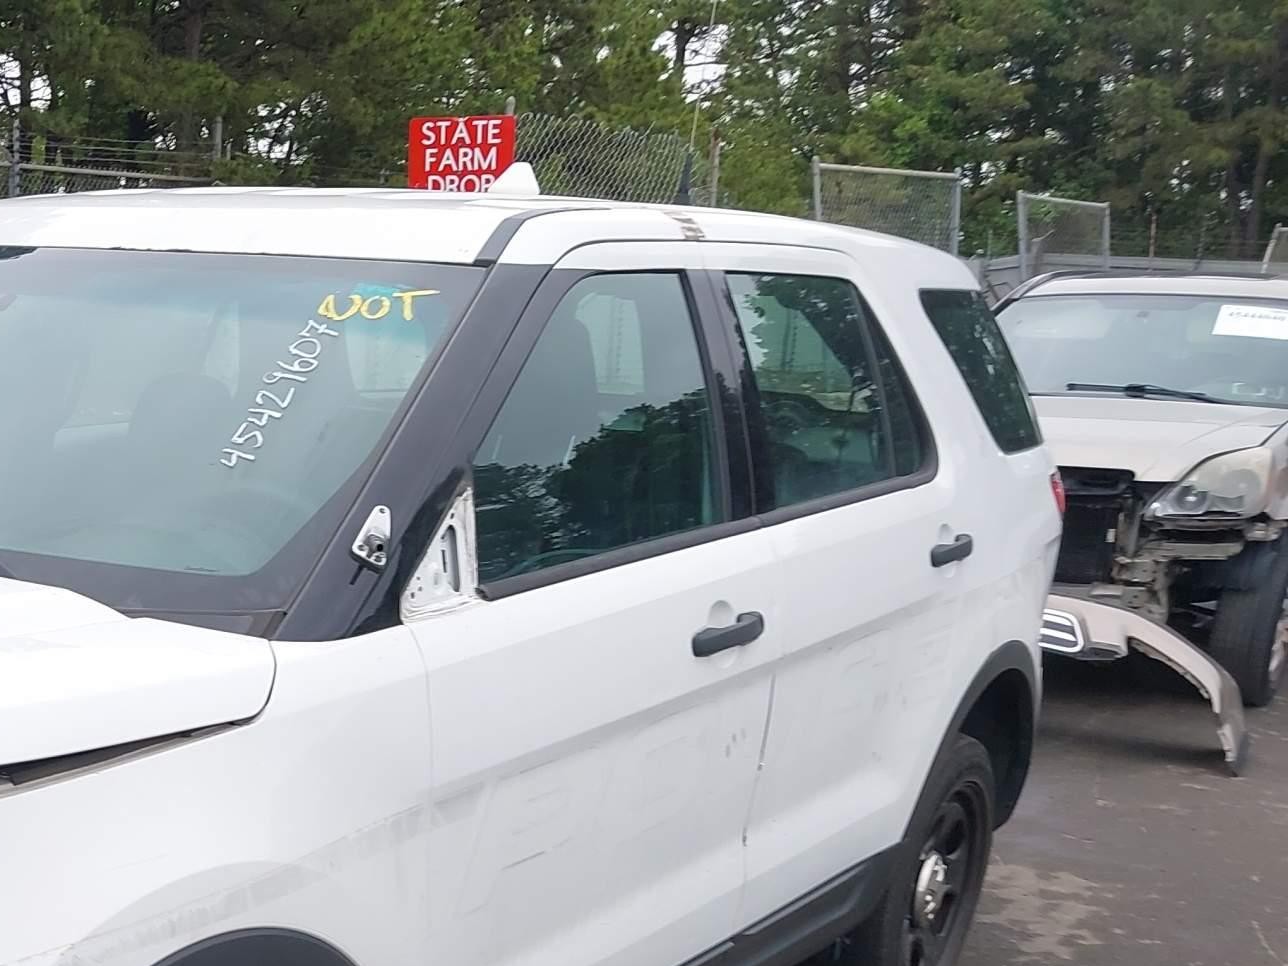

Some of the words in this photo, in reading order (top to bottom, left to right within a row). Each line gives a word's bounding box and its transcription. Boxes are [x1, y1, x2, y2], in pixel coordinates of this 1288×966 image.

[421, 119, 502, 146] STATE
[424, 147, 497, 172] FARM
[427, 174, 496, 193] DROP
[317, 288, 441, 322] NOT
[220, 319, 340, 469] 45429607
